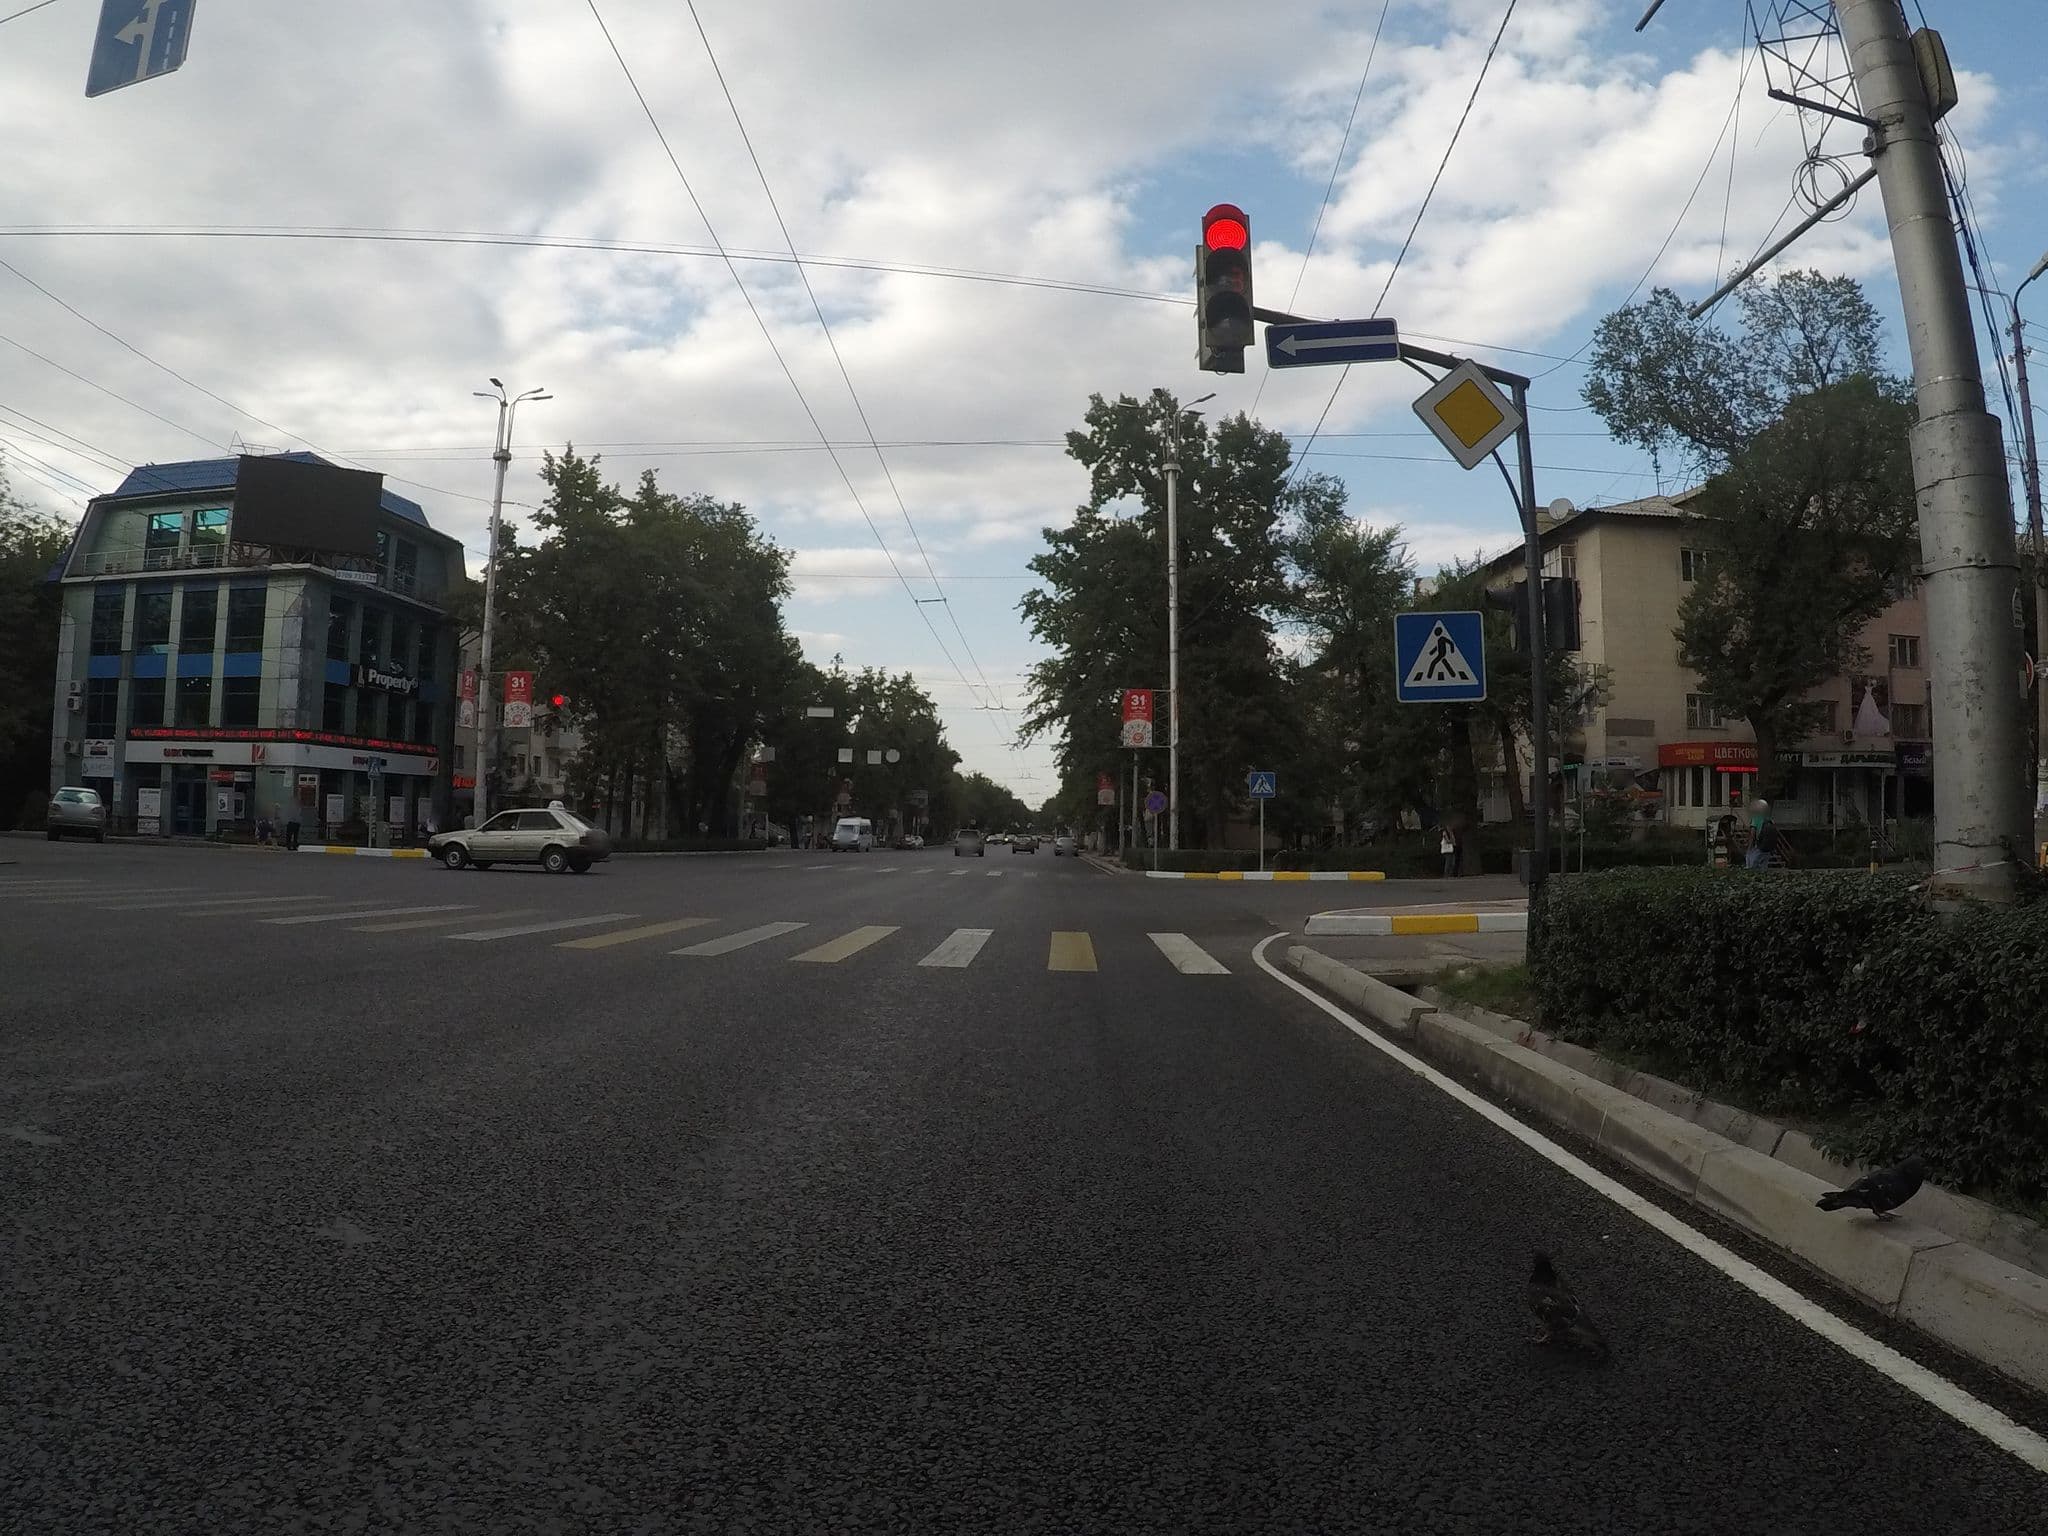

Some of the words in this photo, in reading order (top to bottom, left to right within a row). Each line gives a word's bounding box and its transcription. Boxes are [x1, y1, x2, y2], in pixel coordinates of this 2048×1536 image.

[368, 668, 411, 694] Property
[511, 676, 525, 688] 31
[1131, 694, 1146, 706] 31
